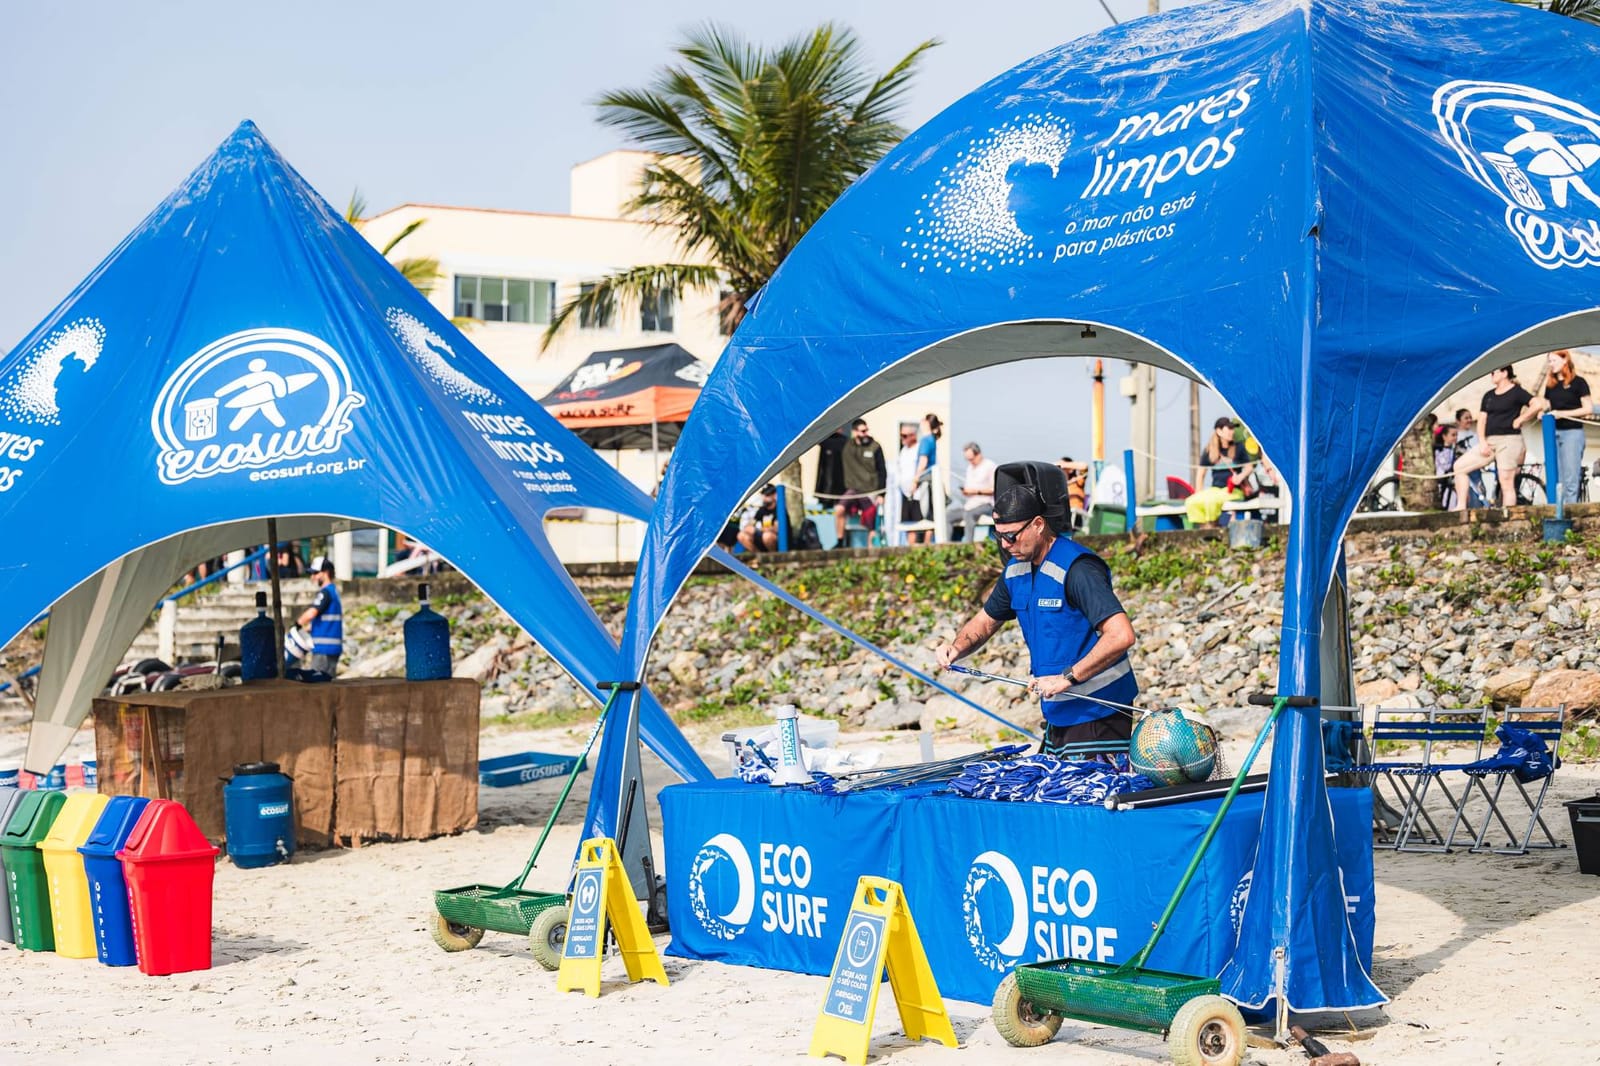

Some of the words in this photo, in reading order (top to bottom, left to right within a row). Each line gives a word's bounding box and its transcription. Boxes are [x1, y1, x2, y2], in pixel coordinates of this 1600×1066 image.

[1101, 78, 1260, 148] mares
[1080, 128, 1244, 199] limpos
[1064, 221, 1077, 235] o
[1080, 213, 1118, 233] mar
[1120, 204, 1155, 225] não
[1159, 190, 1197, 217] está
[1052, 240, 1098, 263] para
[1098, 222, 1176, 256] plásticos
[158, 392, 366, 484] ecosurf
[461, 410, 536, 436] mares
[249, 457, 367, 482] ecosurf.org.br
[481, 432, 565, 469] limpos
[781, 719, 797, 766] ecosurf
[520, 762, 567, 781] ECOSURF
[260, 803, 289, 816] ecosurf
[759, 842, 813, 889] ECO
[761, 890, 829, 939] SURF
[1032, 864, 1099, 919] ECO
[96, 892, 108, 951] PAPEL
[1033, 919, 1119, 964] SURF
